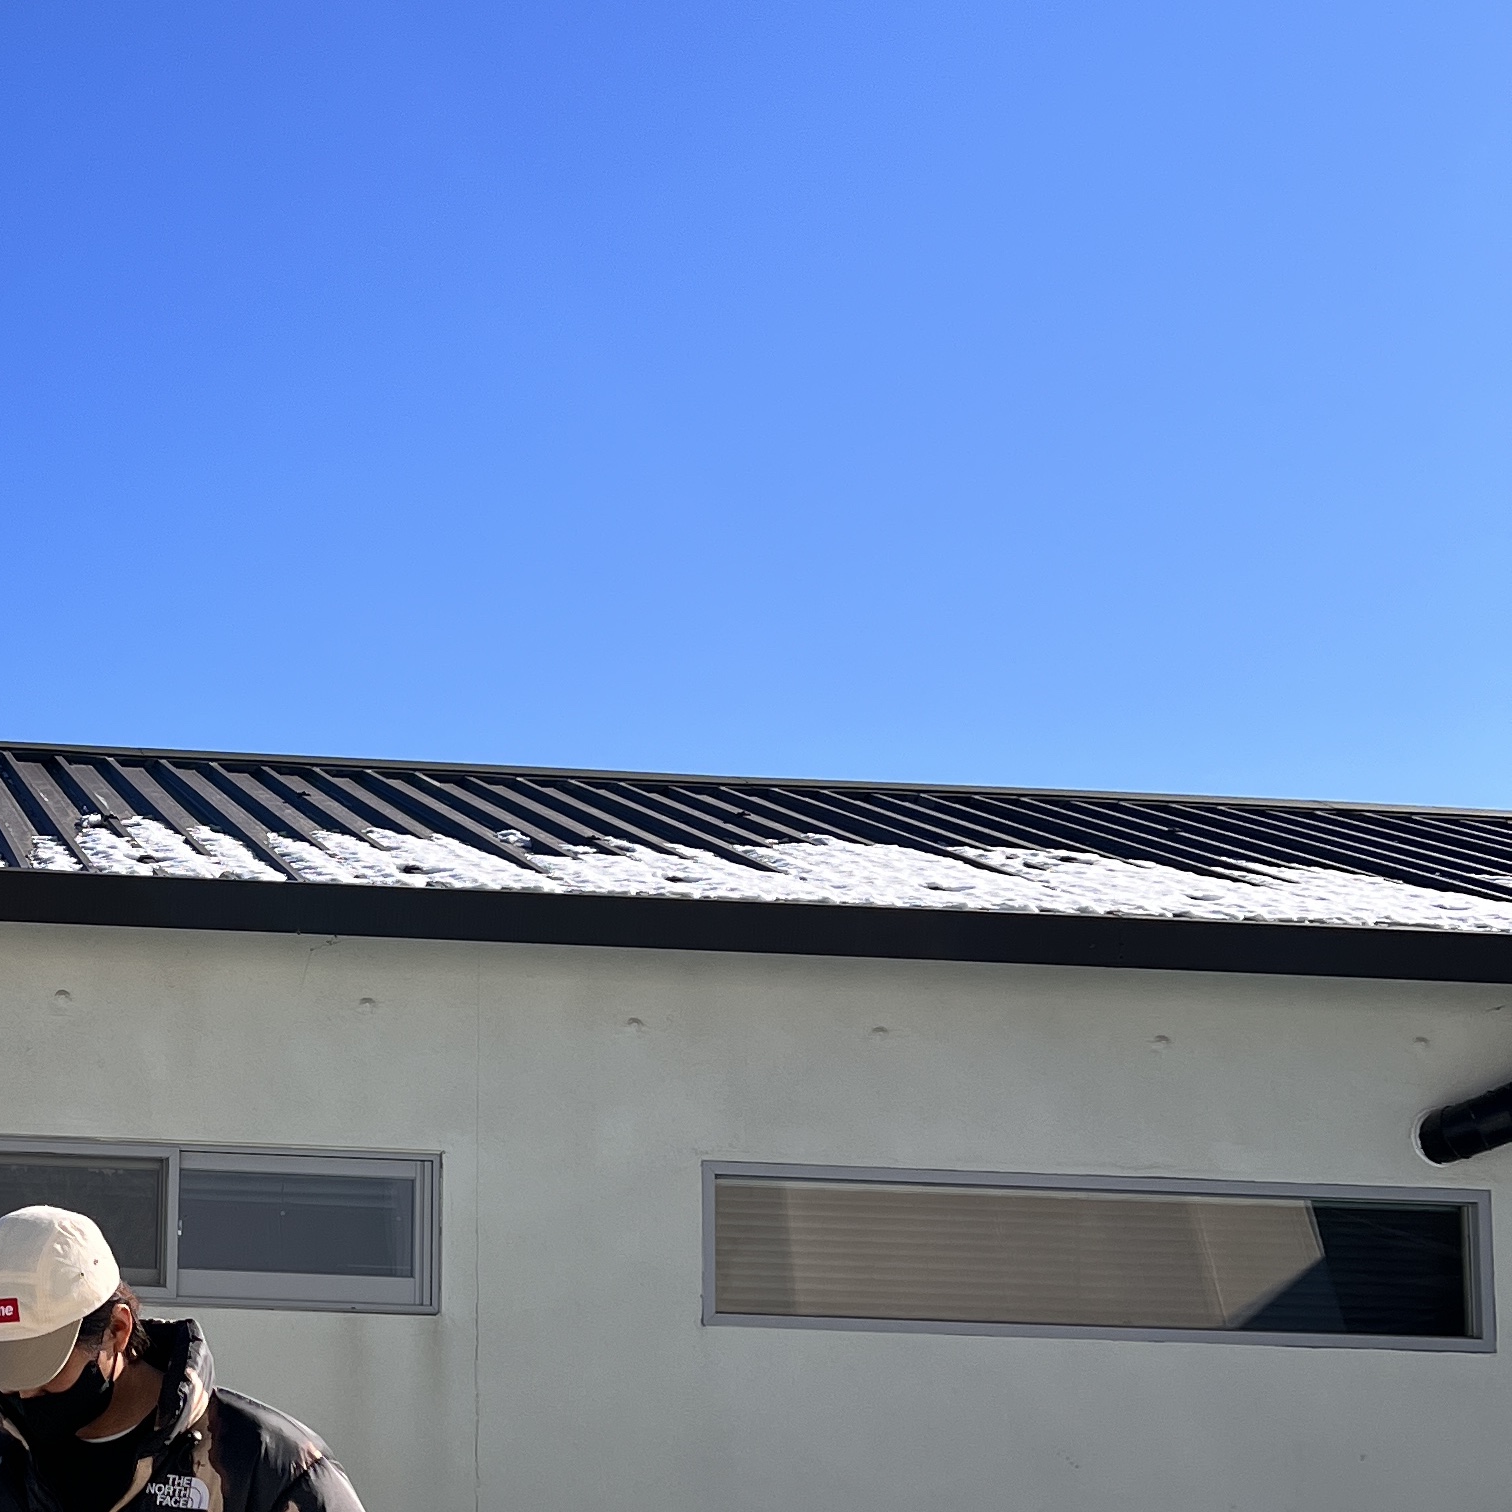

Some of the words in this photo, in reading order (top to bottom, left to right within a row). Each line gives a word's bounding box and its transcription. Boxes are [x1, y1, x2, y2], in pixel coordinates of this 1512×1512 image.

[167, 1474, 192, 1487] THE
[146, 1483, 190, 1498] NORTH
[156, 1495, 188, 1508] FACE
